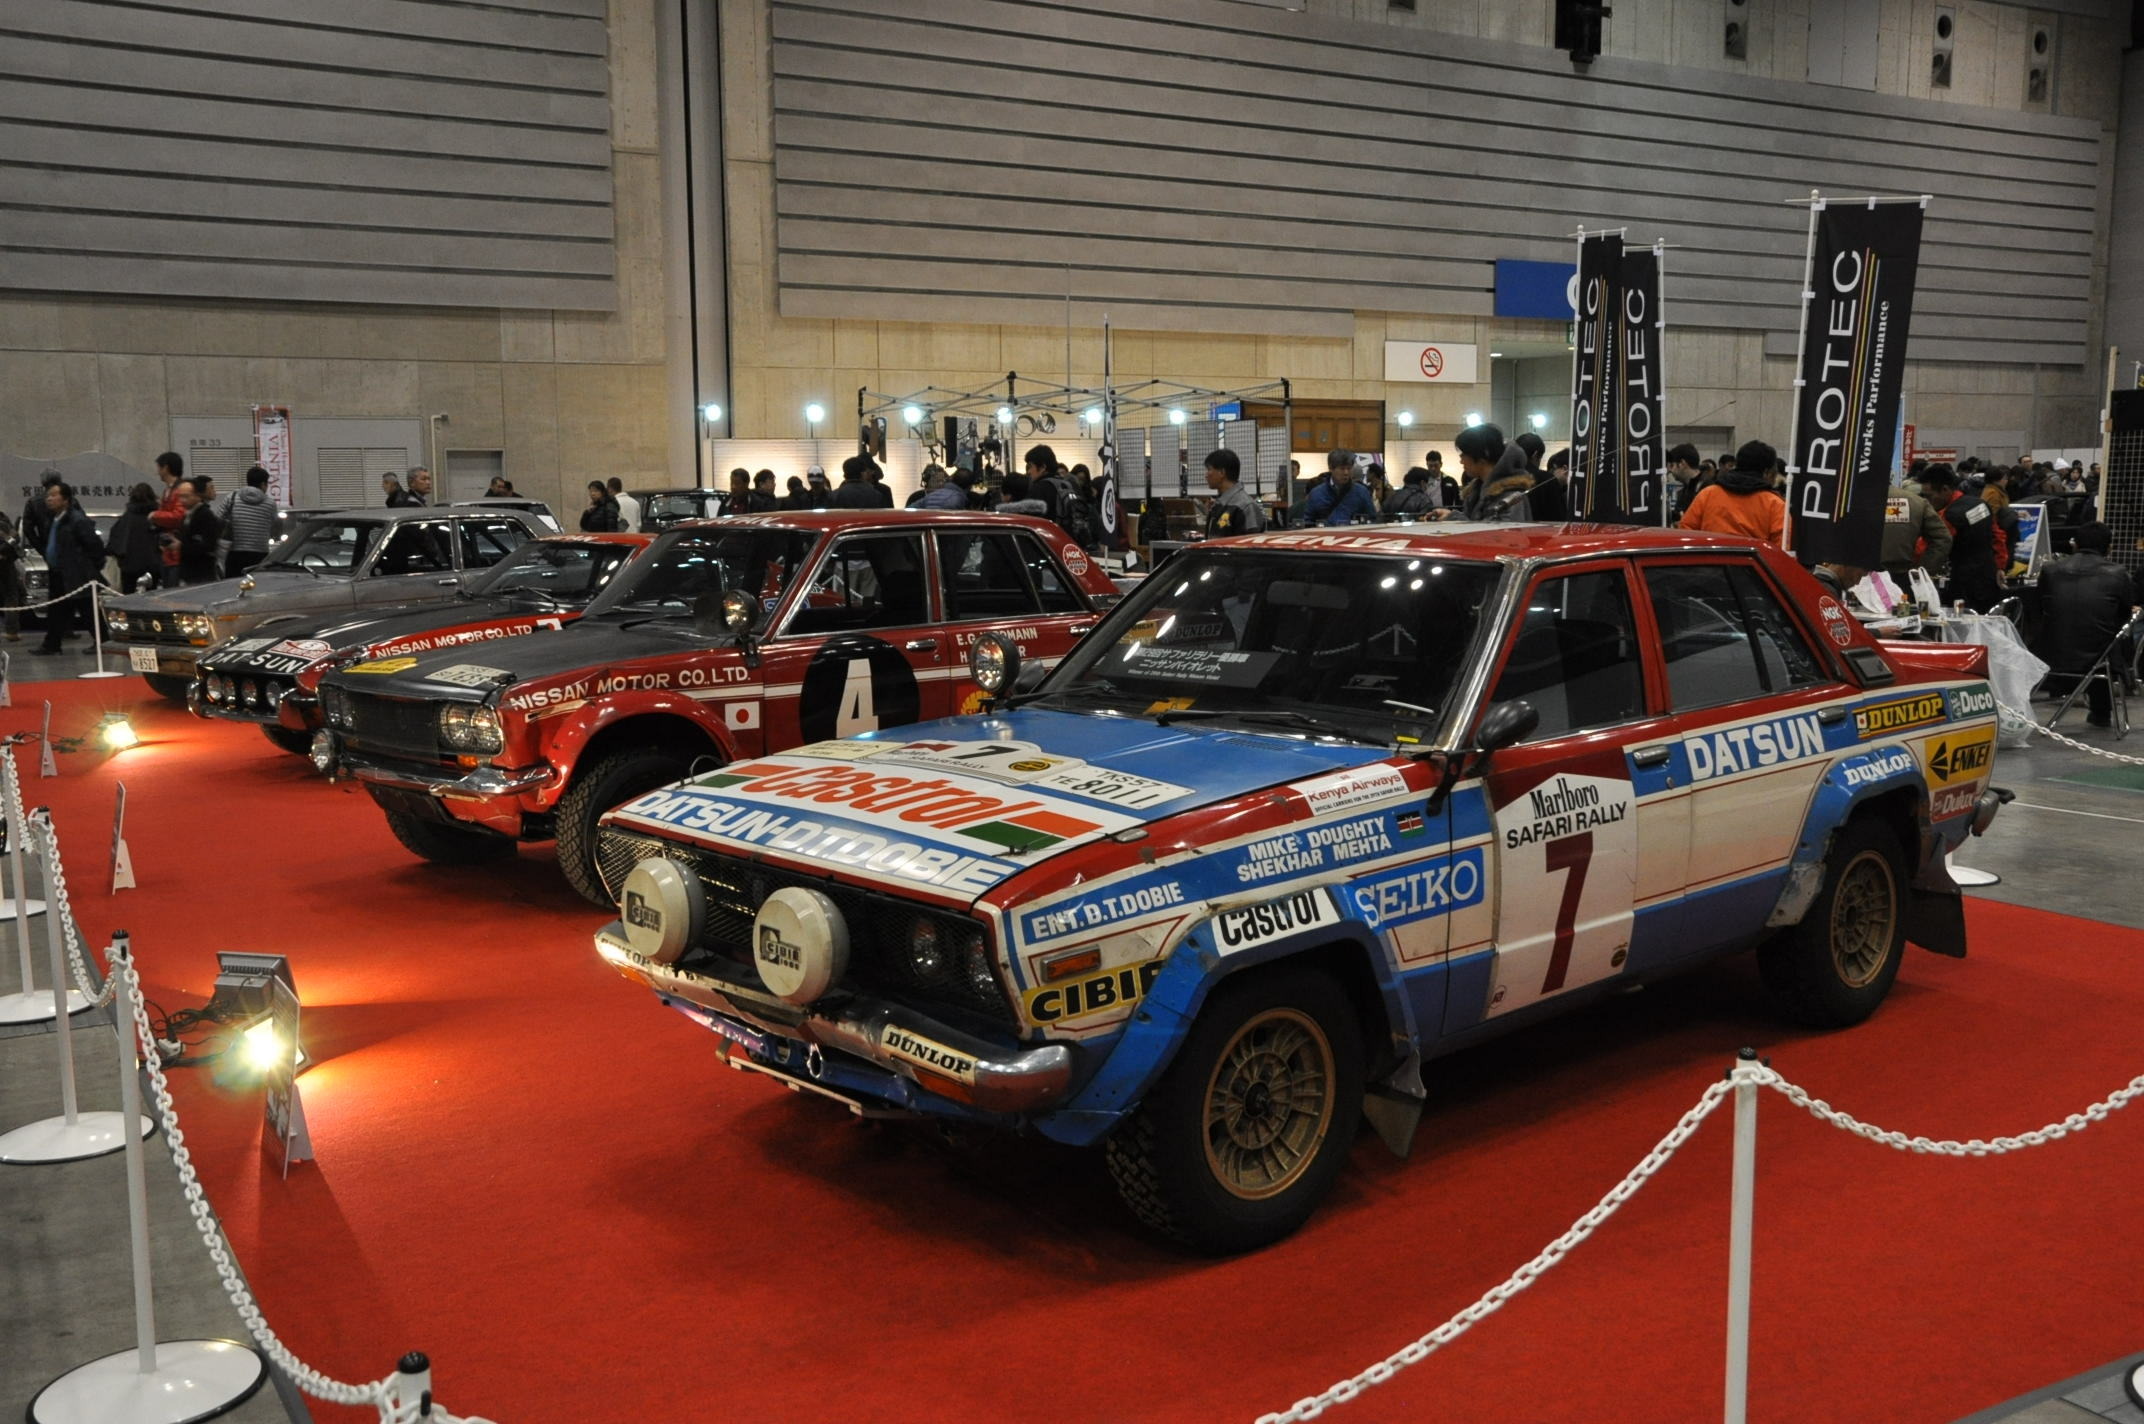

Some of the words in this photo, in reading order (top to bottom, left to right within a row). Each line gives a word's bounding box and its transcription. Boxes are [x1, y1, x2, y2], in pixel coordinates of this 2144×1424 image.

[1802, 250, 1862, 520] PROTEC
[1858, 422, 1876, 474] Works
[1240, 534, 1411, 550] KENYA
[1822, 606, 1843, 622] NGK
[375, 638, 432, 659] NISSAN
[435, 629, 484, 647] MOTOR
[510, 682, 589, 710] NISSAN
[597, 673, 670, 694] MOTOR
[836, 658, 879, 739] 4
[1959, 690, 1994, 713] Duco
[1868, 697, 1944, 730] DUNLOP
[951, 745, 1019, 760] 7
[1683, 714, 1826, 780] DATSUN
[1950, 741, 1992, 774] ENKEI
[1050, 775, 1081, 785] TE
[1071, 779, 1159, 804] 8011
[1307, 786, 1350, 803] Kenya
[1352, 774, 1401, 793] Airways
[1843, 754, 1912, 786] DUNLOP
[741, 765, 1045, 829] Castrol
[1530, 778, 1600, 820] Marlboro
[1248, 836, 1300, 861] MIKE
[1307, 816, 1385, 847] DOUGHTY
[1507, 815, 1572, 849] SAFARI
[1576, 801, 1628, 831] RALLY
[1237, 850, 1323, 882] SHEKHAR
[1333, 833, 1392, 860] MEHTA
[1354, 859, 1479, 929] SEIKO
[1540, 830, 1593, 995] 7
[1218, 889, 1322, 947] Castrol
[767, 942, 799, 961] CIBIE
[885, 1030, 973, 1074] DUNLOP
